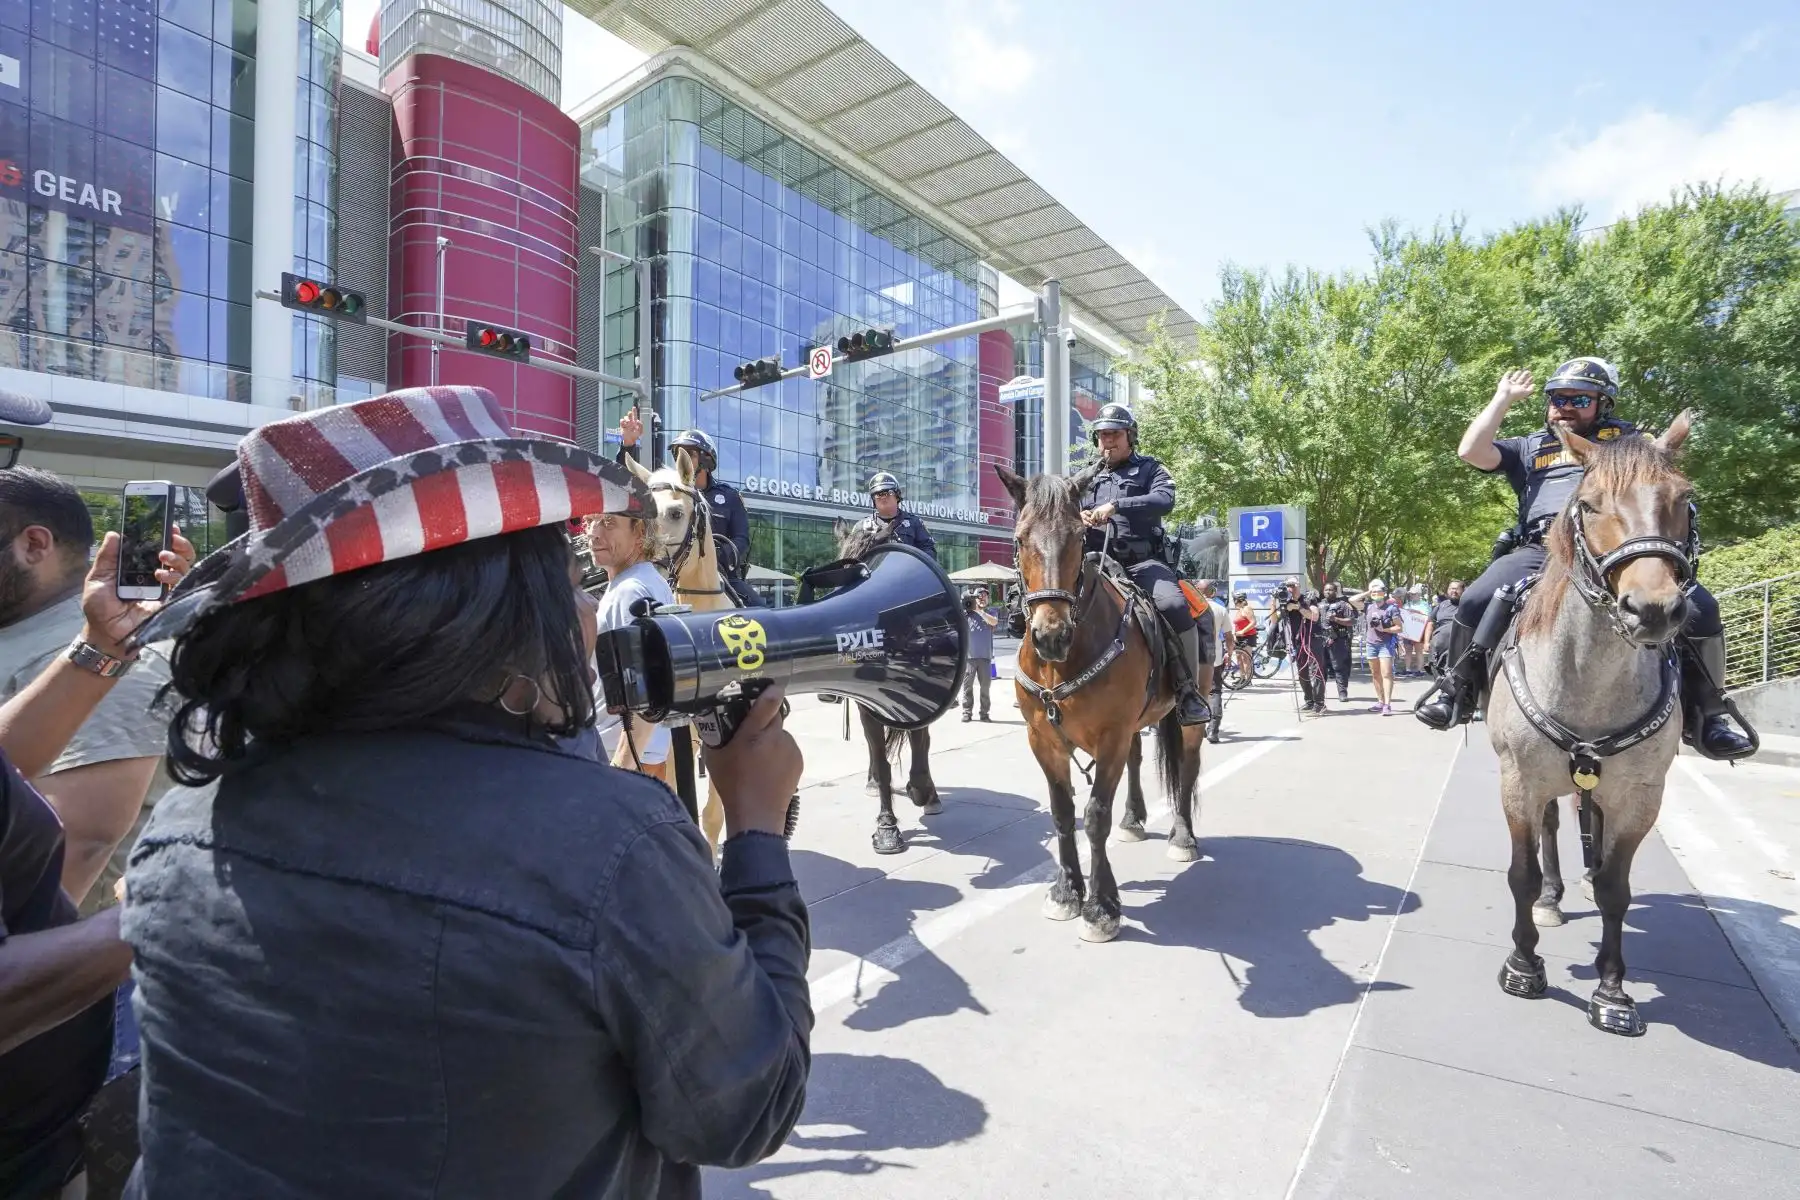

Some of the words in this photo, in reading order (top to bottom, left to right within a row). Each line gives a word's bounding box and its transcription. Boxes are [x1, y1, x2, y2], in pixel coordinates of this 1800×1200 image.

[34, 169, 122, 216] GEAR
[745, 476, 811, 499] GEORGE
[815, 485, 828, 501] R.
[833, 488, 874, 508] BROW
[899, 499, 954, 519] NVENTION
[956, 508, 989, 525] CENTER
[1252, 515, 1270, 537] P
[1244, 541, 1279, 550] SPACES
[1255, 551, 1280, 561] 137
[835, 629, 885, 652] PYLE
[1076, 661, 1107, 686] POLICE
[1514, 681, 1544, 724] POLICE
[1640, 697, 1675, 736] POLICE
